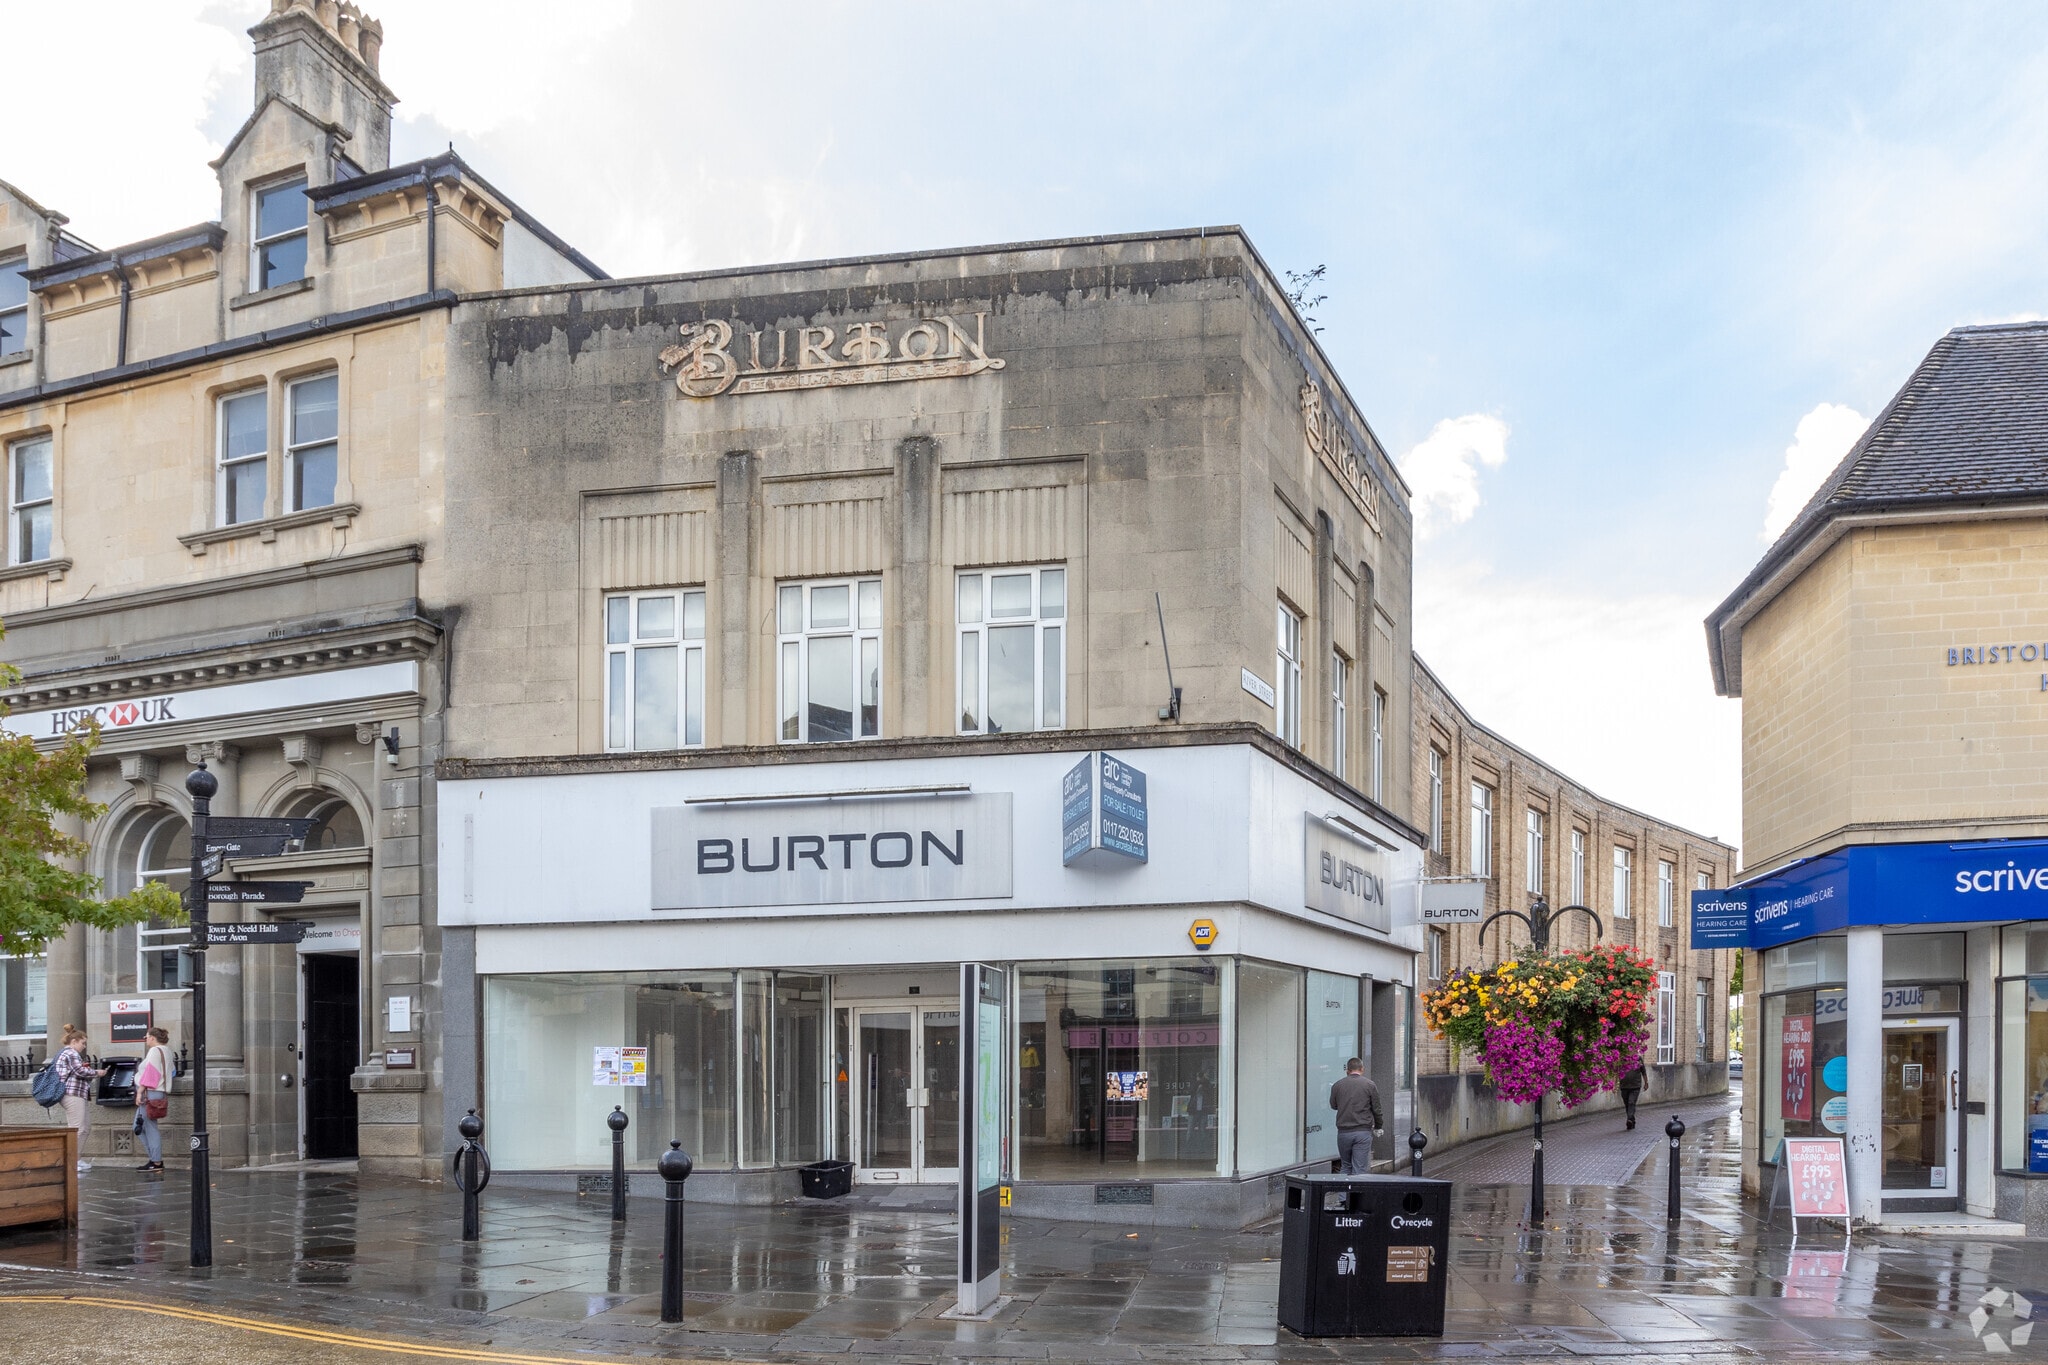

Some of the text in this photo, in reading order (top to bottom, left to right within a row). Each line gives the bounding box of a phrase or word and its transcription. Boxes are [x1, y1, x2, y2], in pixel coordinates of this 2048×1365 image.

[659, 311, 1006, 398] BURTON
[141, 697, 176, 722] UK
[1103, 757, 1120, 781] arc
[1135, 808, 1145, 821] LET
[1103, 818, 1145, 846] 0117 252 0532
[226, 843, 241, 851] Gate
[697, 829, 964, 875] BURTON
[1320, 849, 1385, 907] BURTON
[1955, 860, 2048, 893] scrive
[208, 892, 266, 901] Borough Parade
[1697, 900, 1748, 912] scrivens
[1754, 886, 1834, 924] scrivens HEARING CARE
[1424, 908, 1479, 918] BURTON
[207, 925, 226, 933] Town
[227, 925, 236, 933] &
[259, 924, 278, 932] Halls
[1696, 920, 1728, 928] HEARING
[207, 933, 248, 942] River Avon
[333, 929, 341, 937] to
[1195, 928, 1210, 936] ADT
[1783, 1031, 1811, 1044] HEARING AIDS
[1788, 1048, 1805, 1069] £995
[1801, 1145, 1827, 1153] DIGITAL
[1790, 1153, 1841, 1162] HEARING AIDS
[1802, 1164, 1832, 1179] £995
[1335, 1217, 1363, 1227] Litter
[1405, 1217, 1433, 1228] recycle
